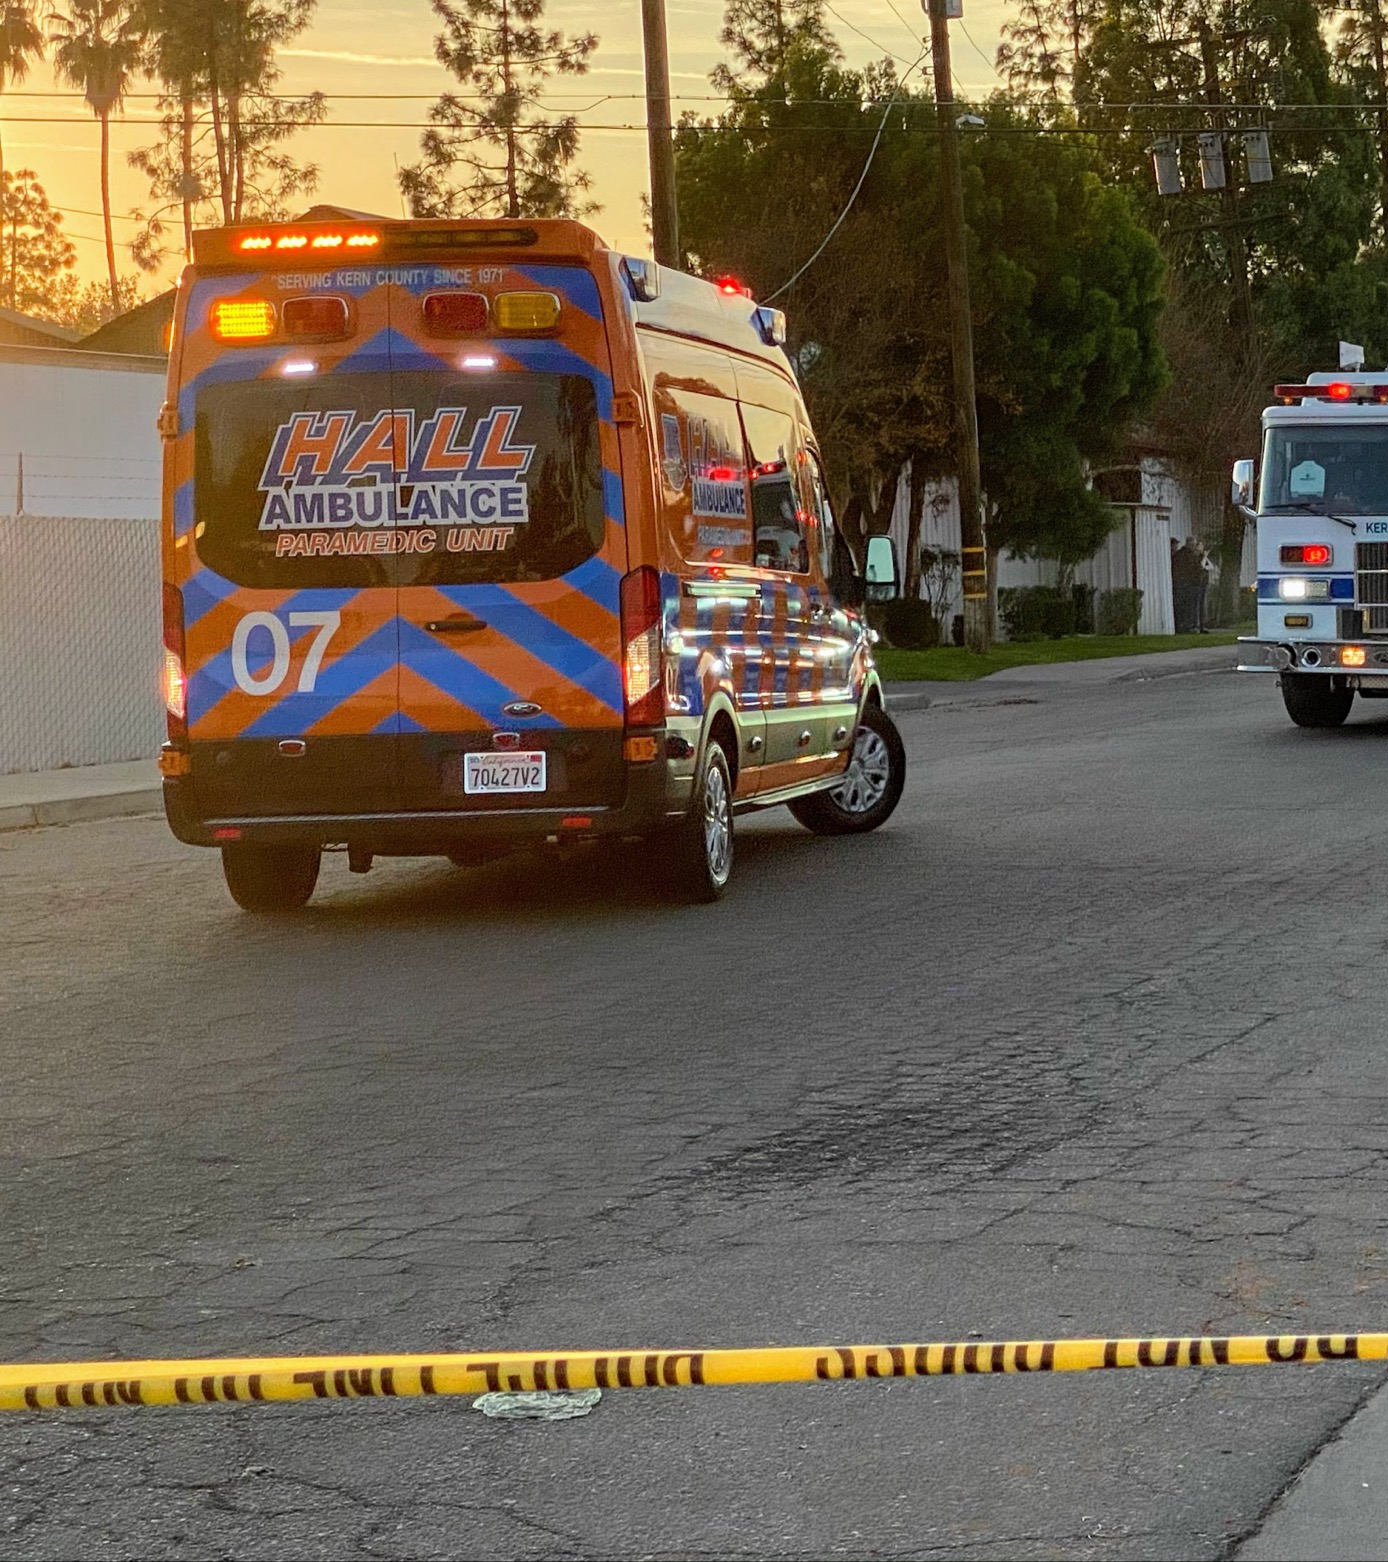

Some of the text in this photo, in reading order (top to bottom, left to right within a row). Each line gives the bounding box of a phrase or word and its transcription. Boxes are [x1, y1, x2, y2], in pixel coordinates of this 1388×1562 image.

[336, 271, 371, 287] KERN
[375, 269, 428, 286] COUNTY
[433, 268, 472, 285] SINCE
[260, 406, 536, 489] HALL
[262, 485, 527, 528] AMBULANCE
[693, 482, 746, 517] AMBULANCE
[275, 527, 514, 557] PARAMEDIC UNIT
[231, 610, 341, 697] 07
[471, 766, 540, 787] 70427V2
